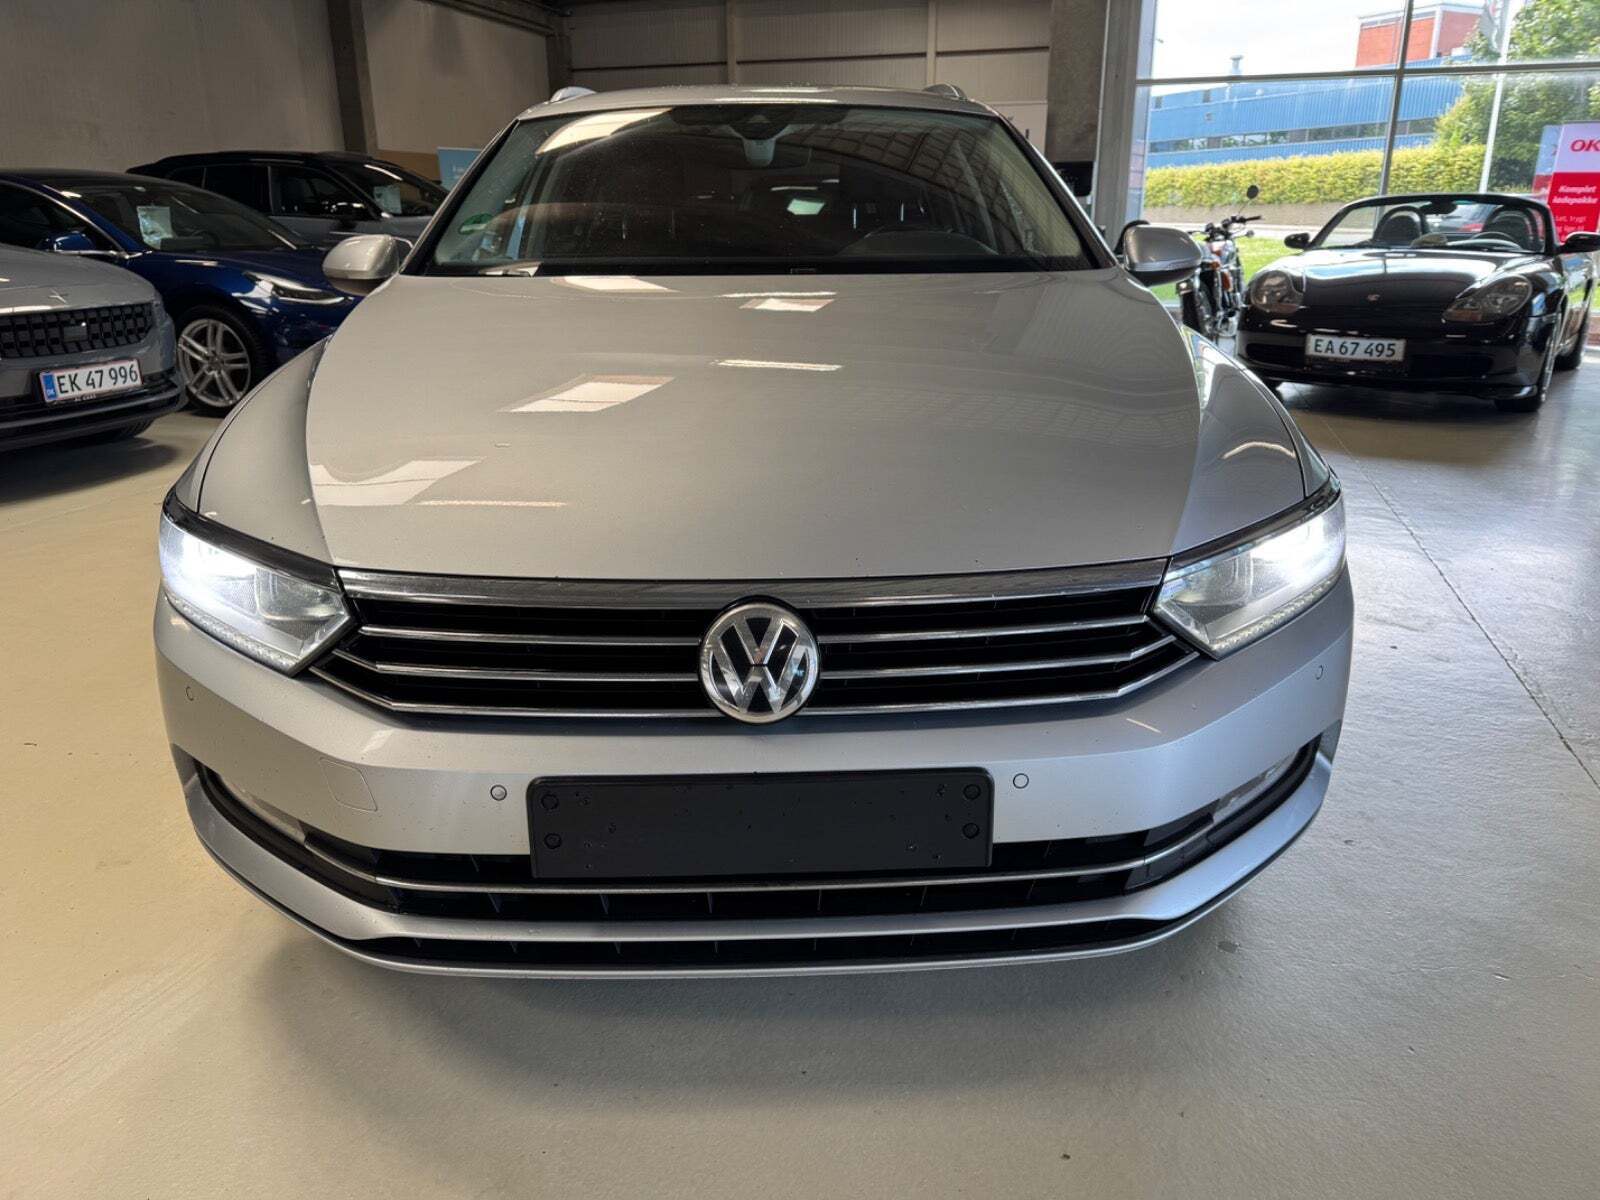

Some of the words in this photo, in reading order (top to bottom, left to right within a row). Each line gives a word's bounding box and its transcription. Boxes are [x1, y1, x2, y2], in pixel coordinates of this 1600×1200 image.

[1570, 139, 1600, 152] OK
[1314, 339, 1335, 354] EA
[1339, 341, 1360, 356] 67
[1364, 343, 1396, 358] 495
[57, 372, 81, 394] EK
[86, 369, 104, 389] 47
[108, 364, 138, 386] 996
